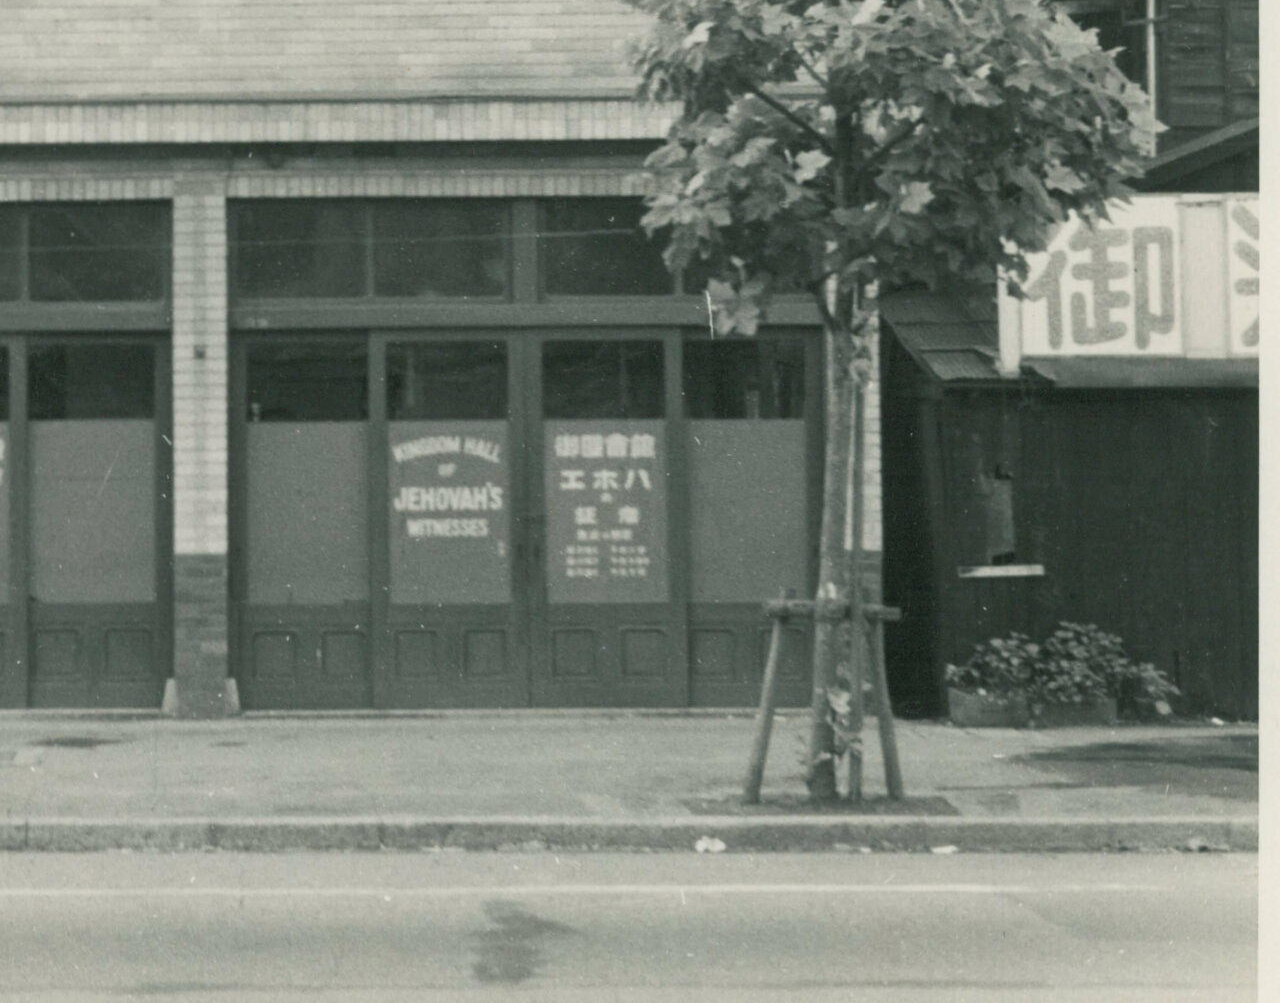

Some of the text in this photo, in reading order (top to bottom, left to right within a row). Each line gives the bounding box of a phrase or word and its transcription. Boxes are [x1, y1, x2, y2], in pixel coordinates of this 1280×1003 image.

[393, 436, 500, 463] KINGDOM HALL
[394, 482, 502, 511] JEHOVAH'S
[407, 518, 488, 537] WITNESSES
